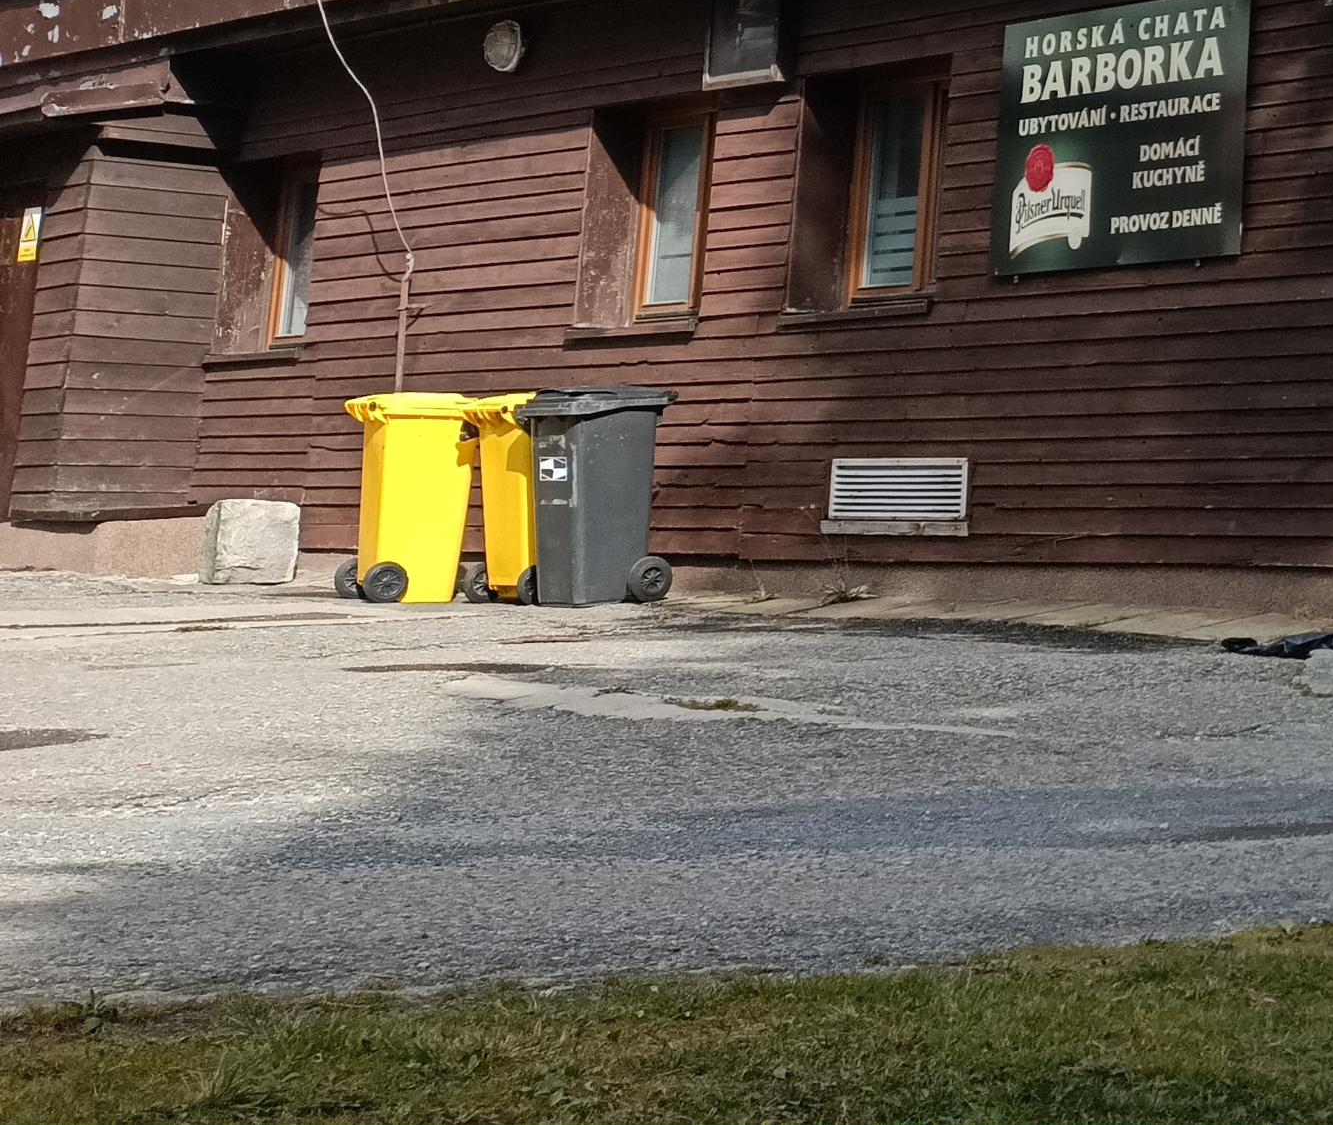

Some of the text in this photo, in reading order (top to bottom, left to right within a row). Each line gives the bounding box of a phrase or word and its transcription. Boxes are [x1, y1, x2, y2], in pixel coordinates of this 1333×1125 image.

[1025, 6, 1226, 58] HORSKÁ CHATA
[1020, 37, 1224, 104] BARBORKA
[1018, 93, 1221, 137] UBYTOVÁNÍ RESTAURACE
[1139, 135, 1200, 162] DOMÁCÍ
[1132, 160, 1206, 189] KUCHYNĚ
[1015, 187, 1085, 235] Pilsner Urquell
[1110, 202, 1223, 234] PROVOZ DENNĚ
